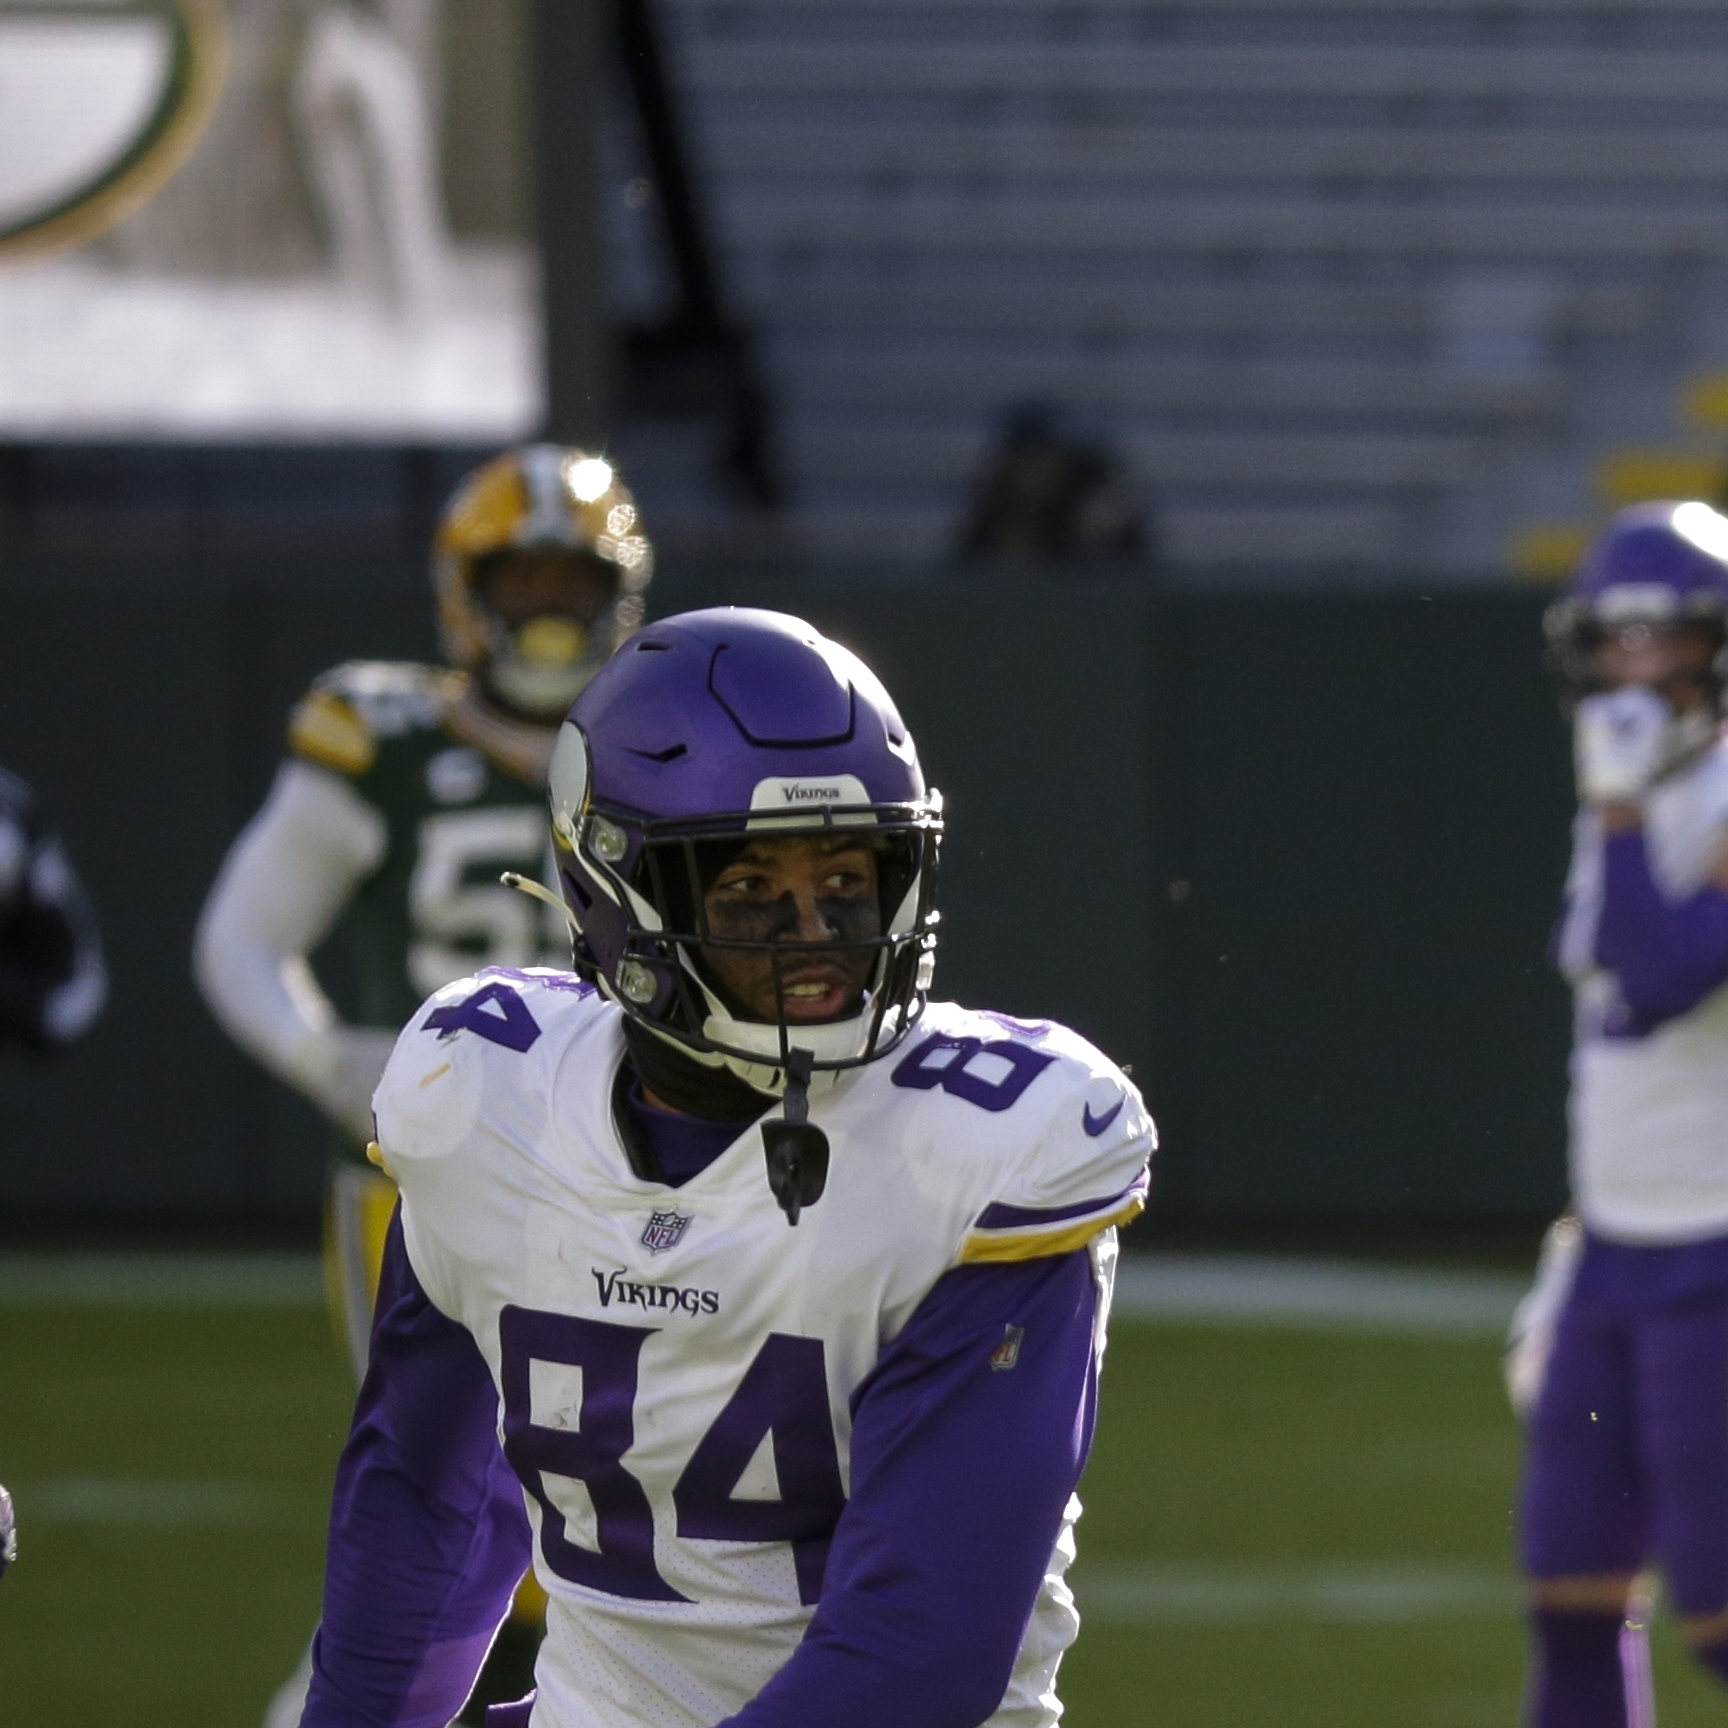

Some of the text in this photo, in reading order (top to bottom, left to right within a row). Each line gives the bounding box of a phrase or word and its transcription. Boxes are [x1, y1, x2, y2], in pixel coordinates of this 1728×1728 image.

[405, 803, 575, 1003] 5
[591, 1266, 720, 1317] VIKINGS
[645, 1222, 676, 1246] NFL
[498, 1302, 852, 1606] 84
